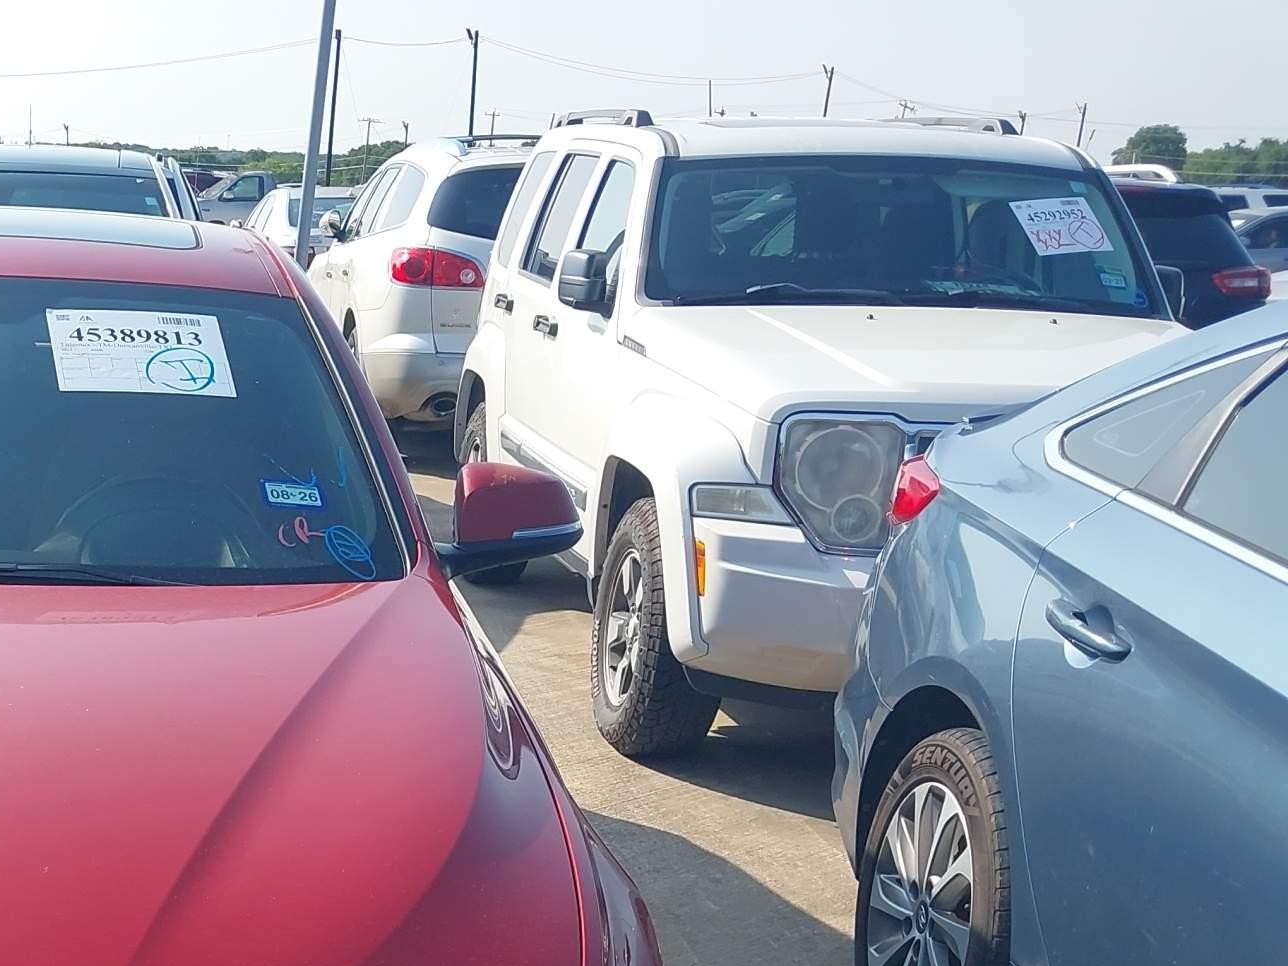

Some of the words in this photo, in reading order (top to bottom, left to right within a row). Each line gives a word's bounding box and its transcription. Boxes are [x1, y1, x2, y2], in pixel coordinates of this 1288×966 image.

[1027, 208, 1087, 223] 45292952
[68, 326, 203, 347] 45389813
[912, 744, 981, 818] SENTURY
